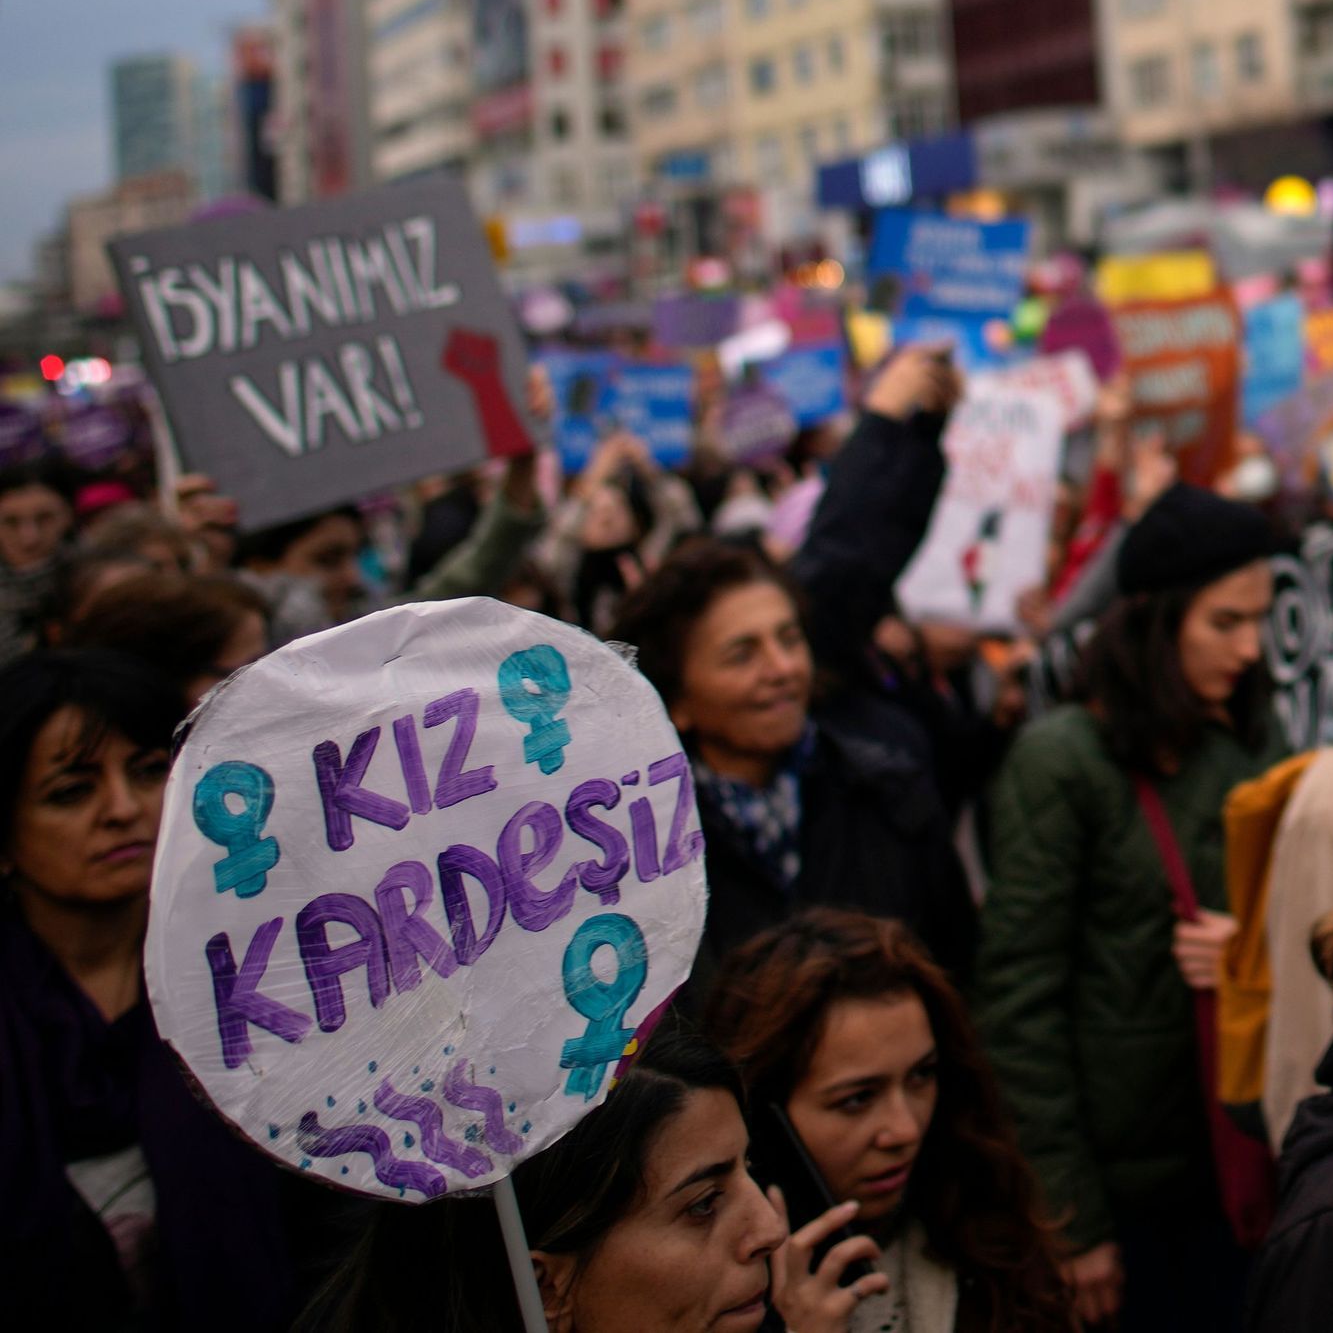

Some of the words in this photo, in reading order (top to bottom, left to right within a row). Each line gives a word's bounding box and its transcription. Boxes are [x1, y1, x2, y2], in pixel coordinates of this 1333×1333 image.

[131, 216, 459, 360] İSYANIMIZ
[232, 337, 424, 456] VAR!
[313, 688, 497, 852] KIZ
